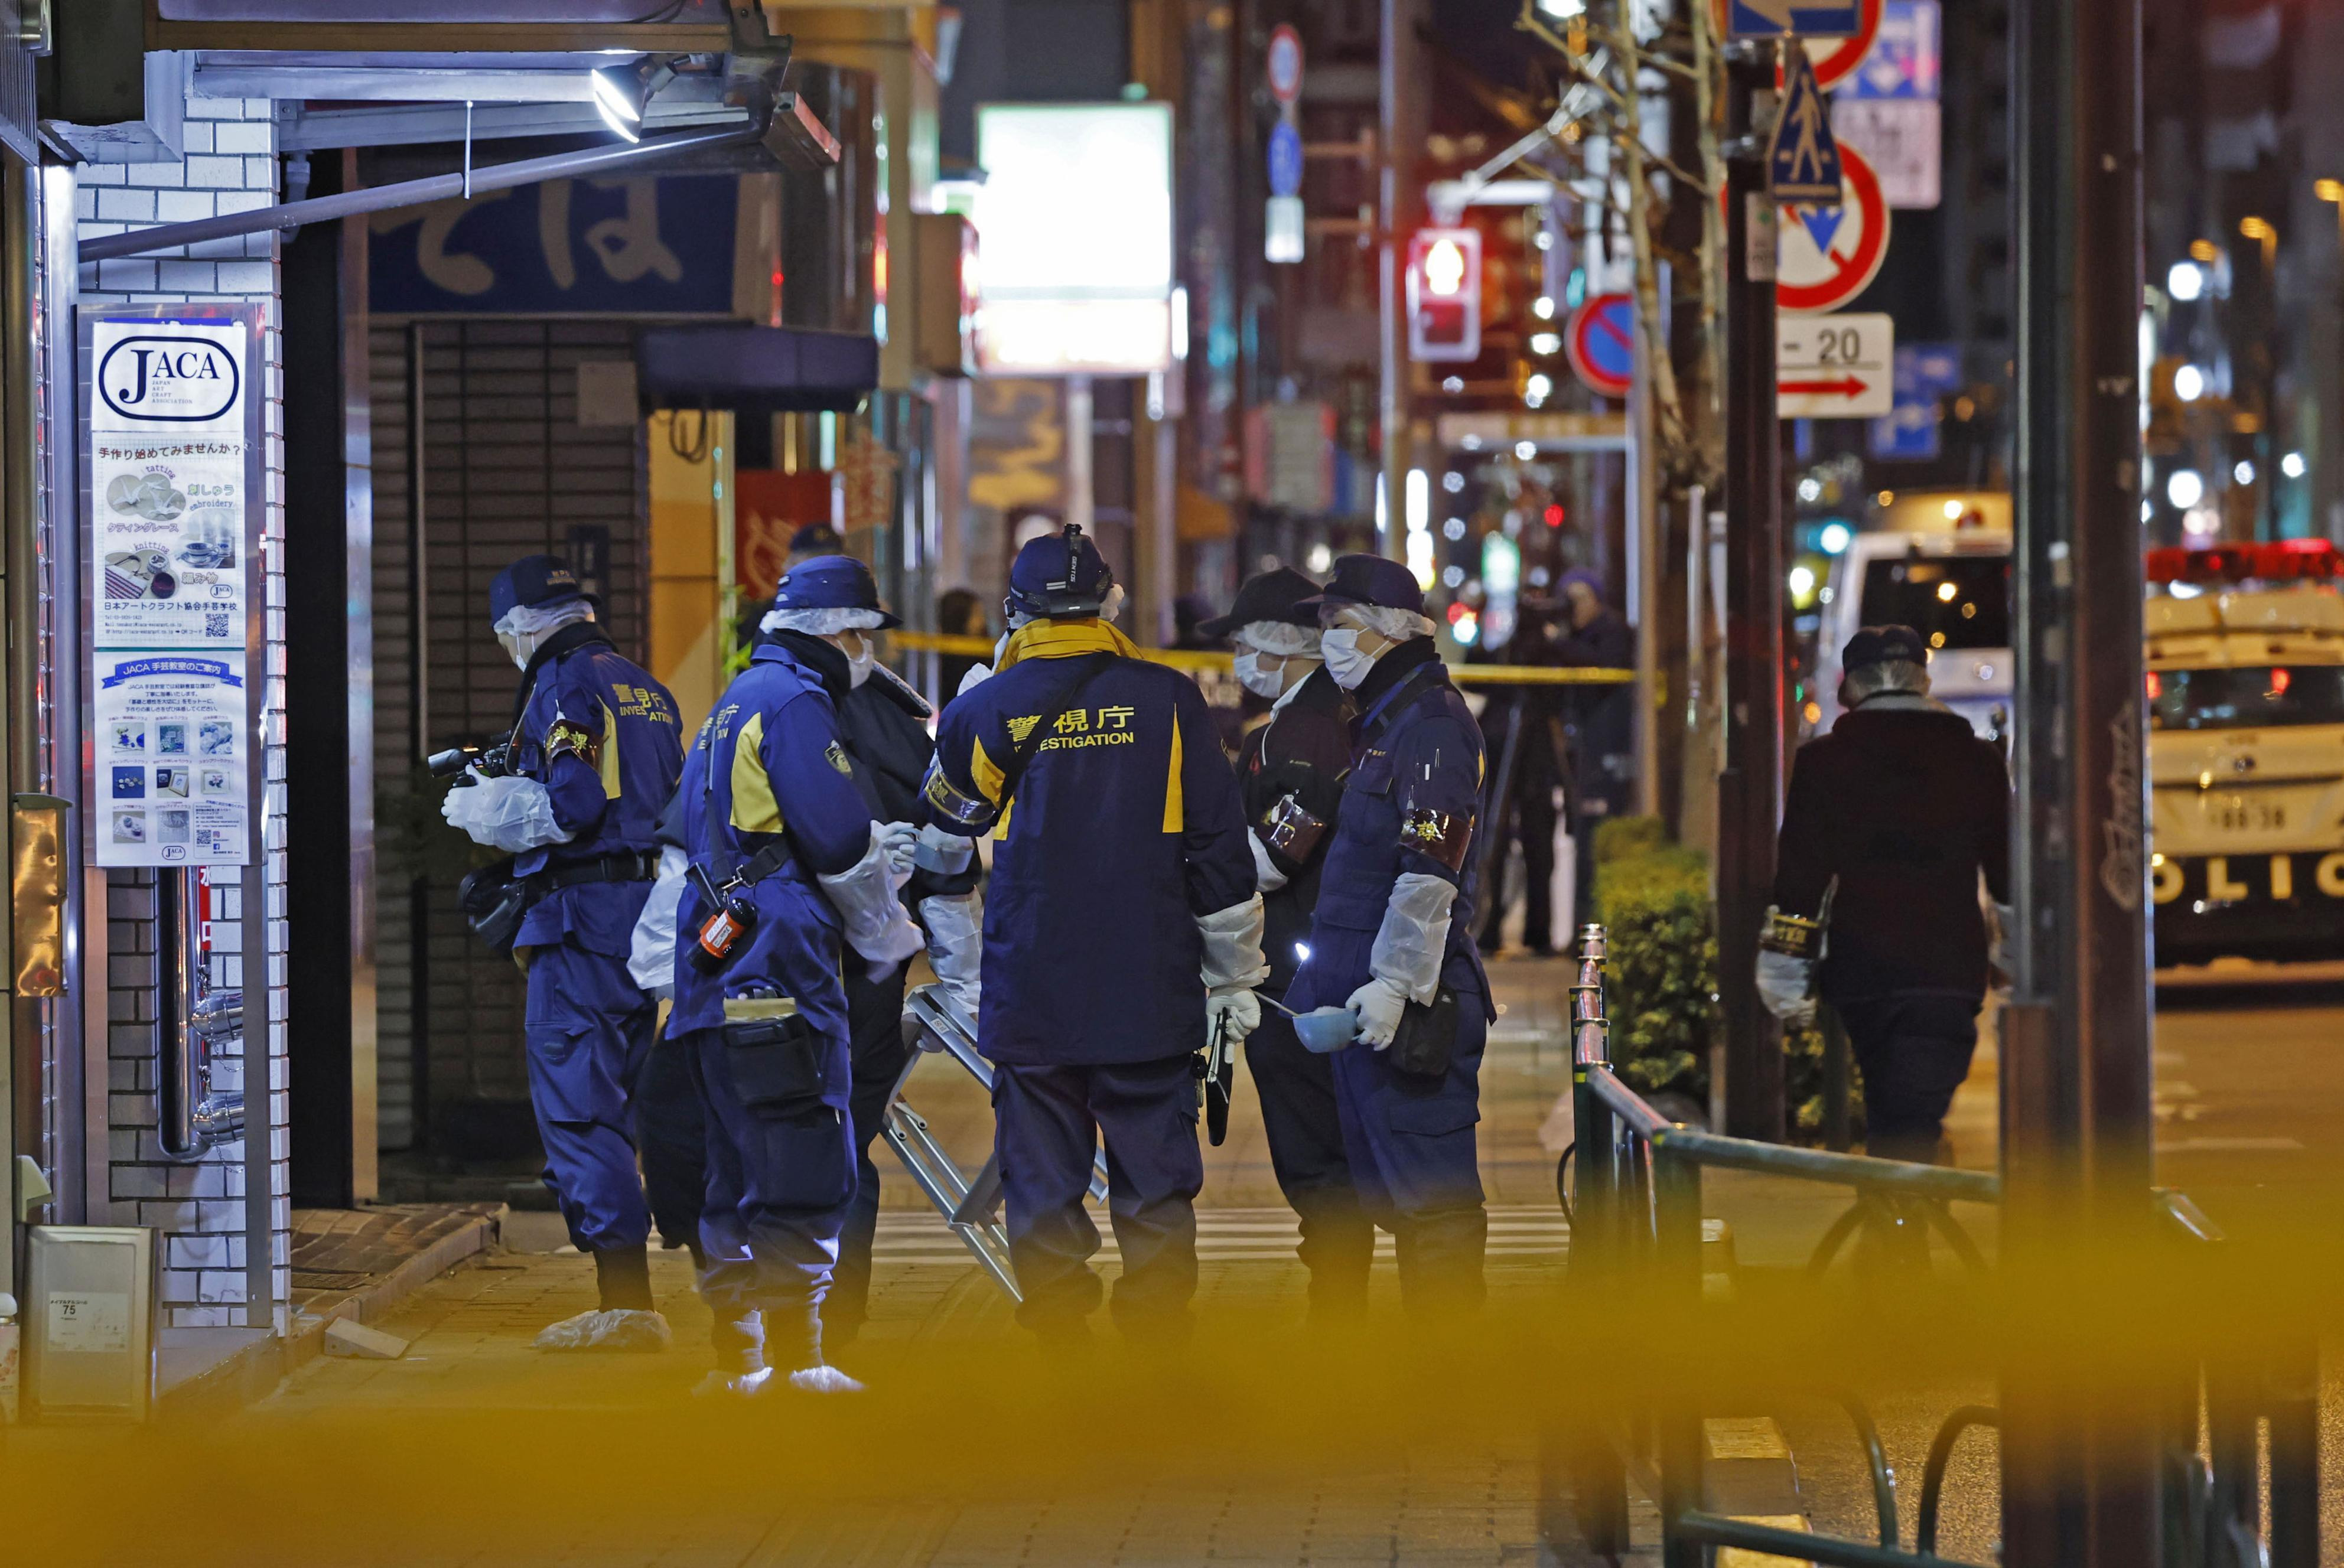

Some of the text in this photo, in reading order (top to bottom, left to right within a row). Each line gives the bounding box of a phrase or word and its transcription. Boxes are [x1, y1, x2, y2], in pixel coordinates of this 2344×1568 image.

[1818, 328, 1860, 365] 20
[119, 350, 220, 404] JACA
[145, 465, 175, 480] tatting
[189, 500, 233, 511] embroidery
[134, 542, 170, 555] knitting
[123, 664, 150, 674] JACA
[1014, 732, 1134, 754] ESTIGATION
[166, 848, 183, 858] JACA
[2152, 854, 2344, 905] OLIC
[63, 1305, 76, 1315] 75
